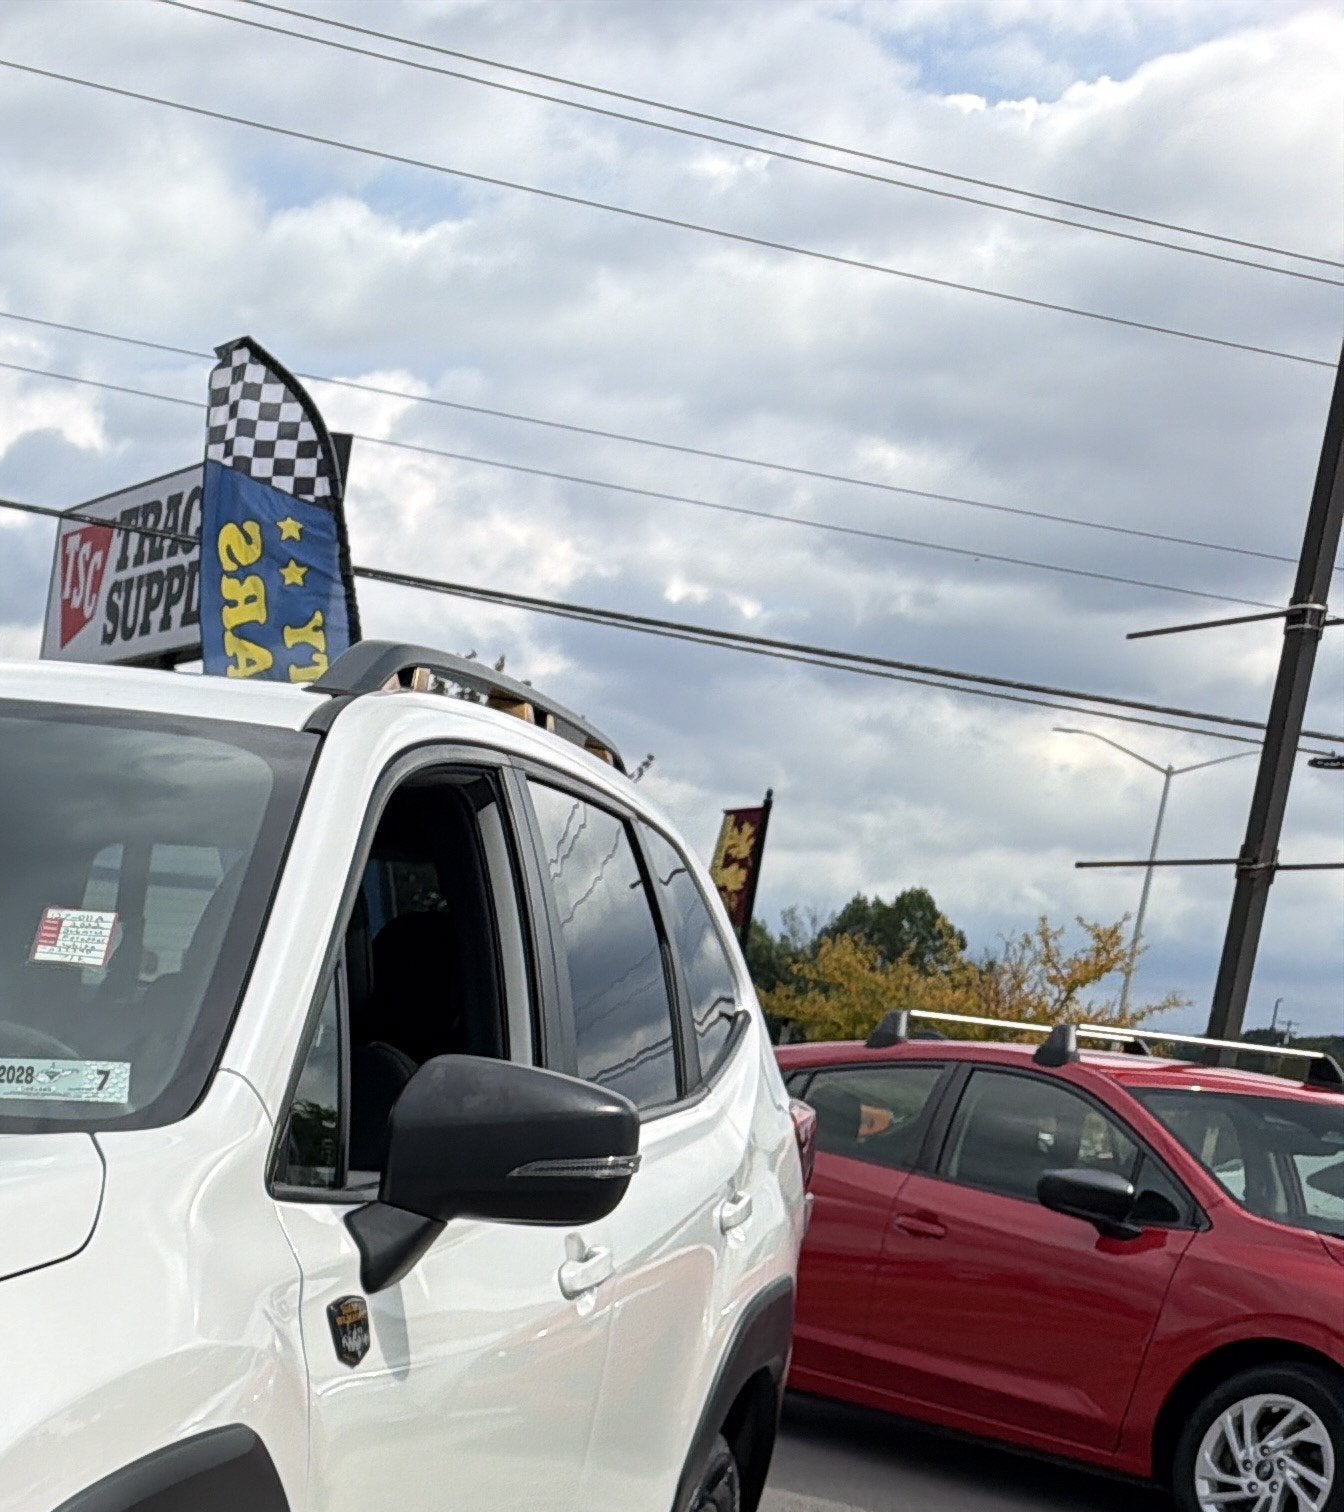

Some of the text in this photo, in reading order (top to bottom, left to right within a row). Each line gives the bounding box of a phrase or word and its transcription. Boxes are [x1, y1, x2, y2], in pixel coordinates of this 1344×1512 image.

[115, 485, 203, 573] TRAC
[63, 532, 104, 619] TSC
[100, 559, 200, 646] SUPPL
[96, 1068, 111, 1092] 7
